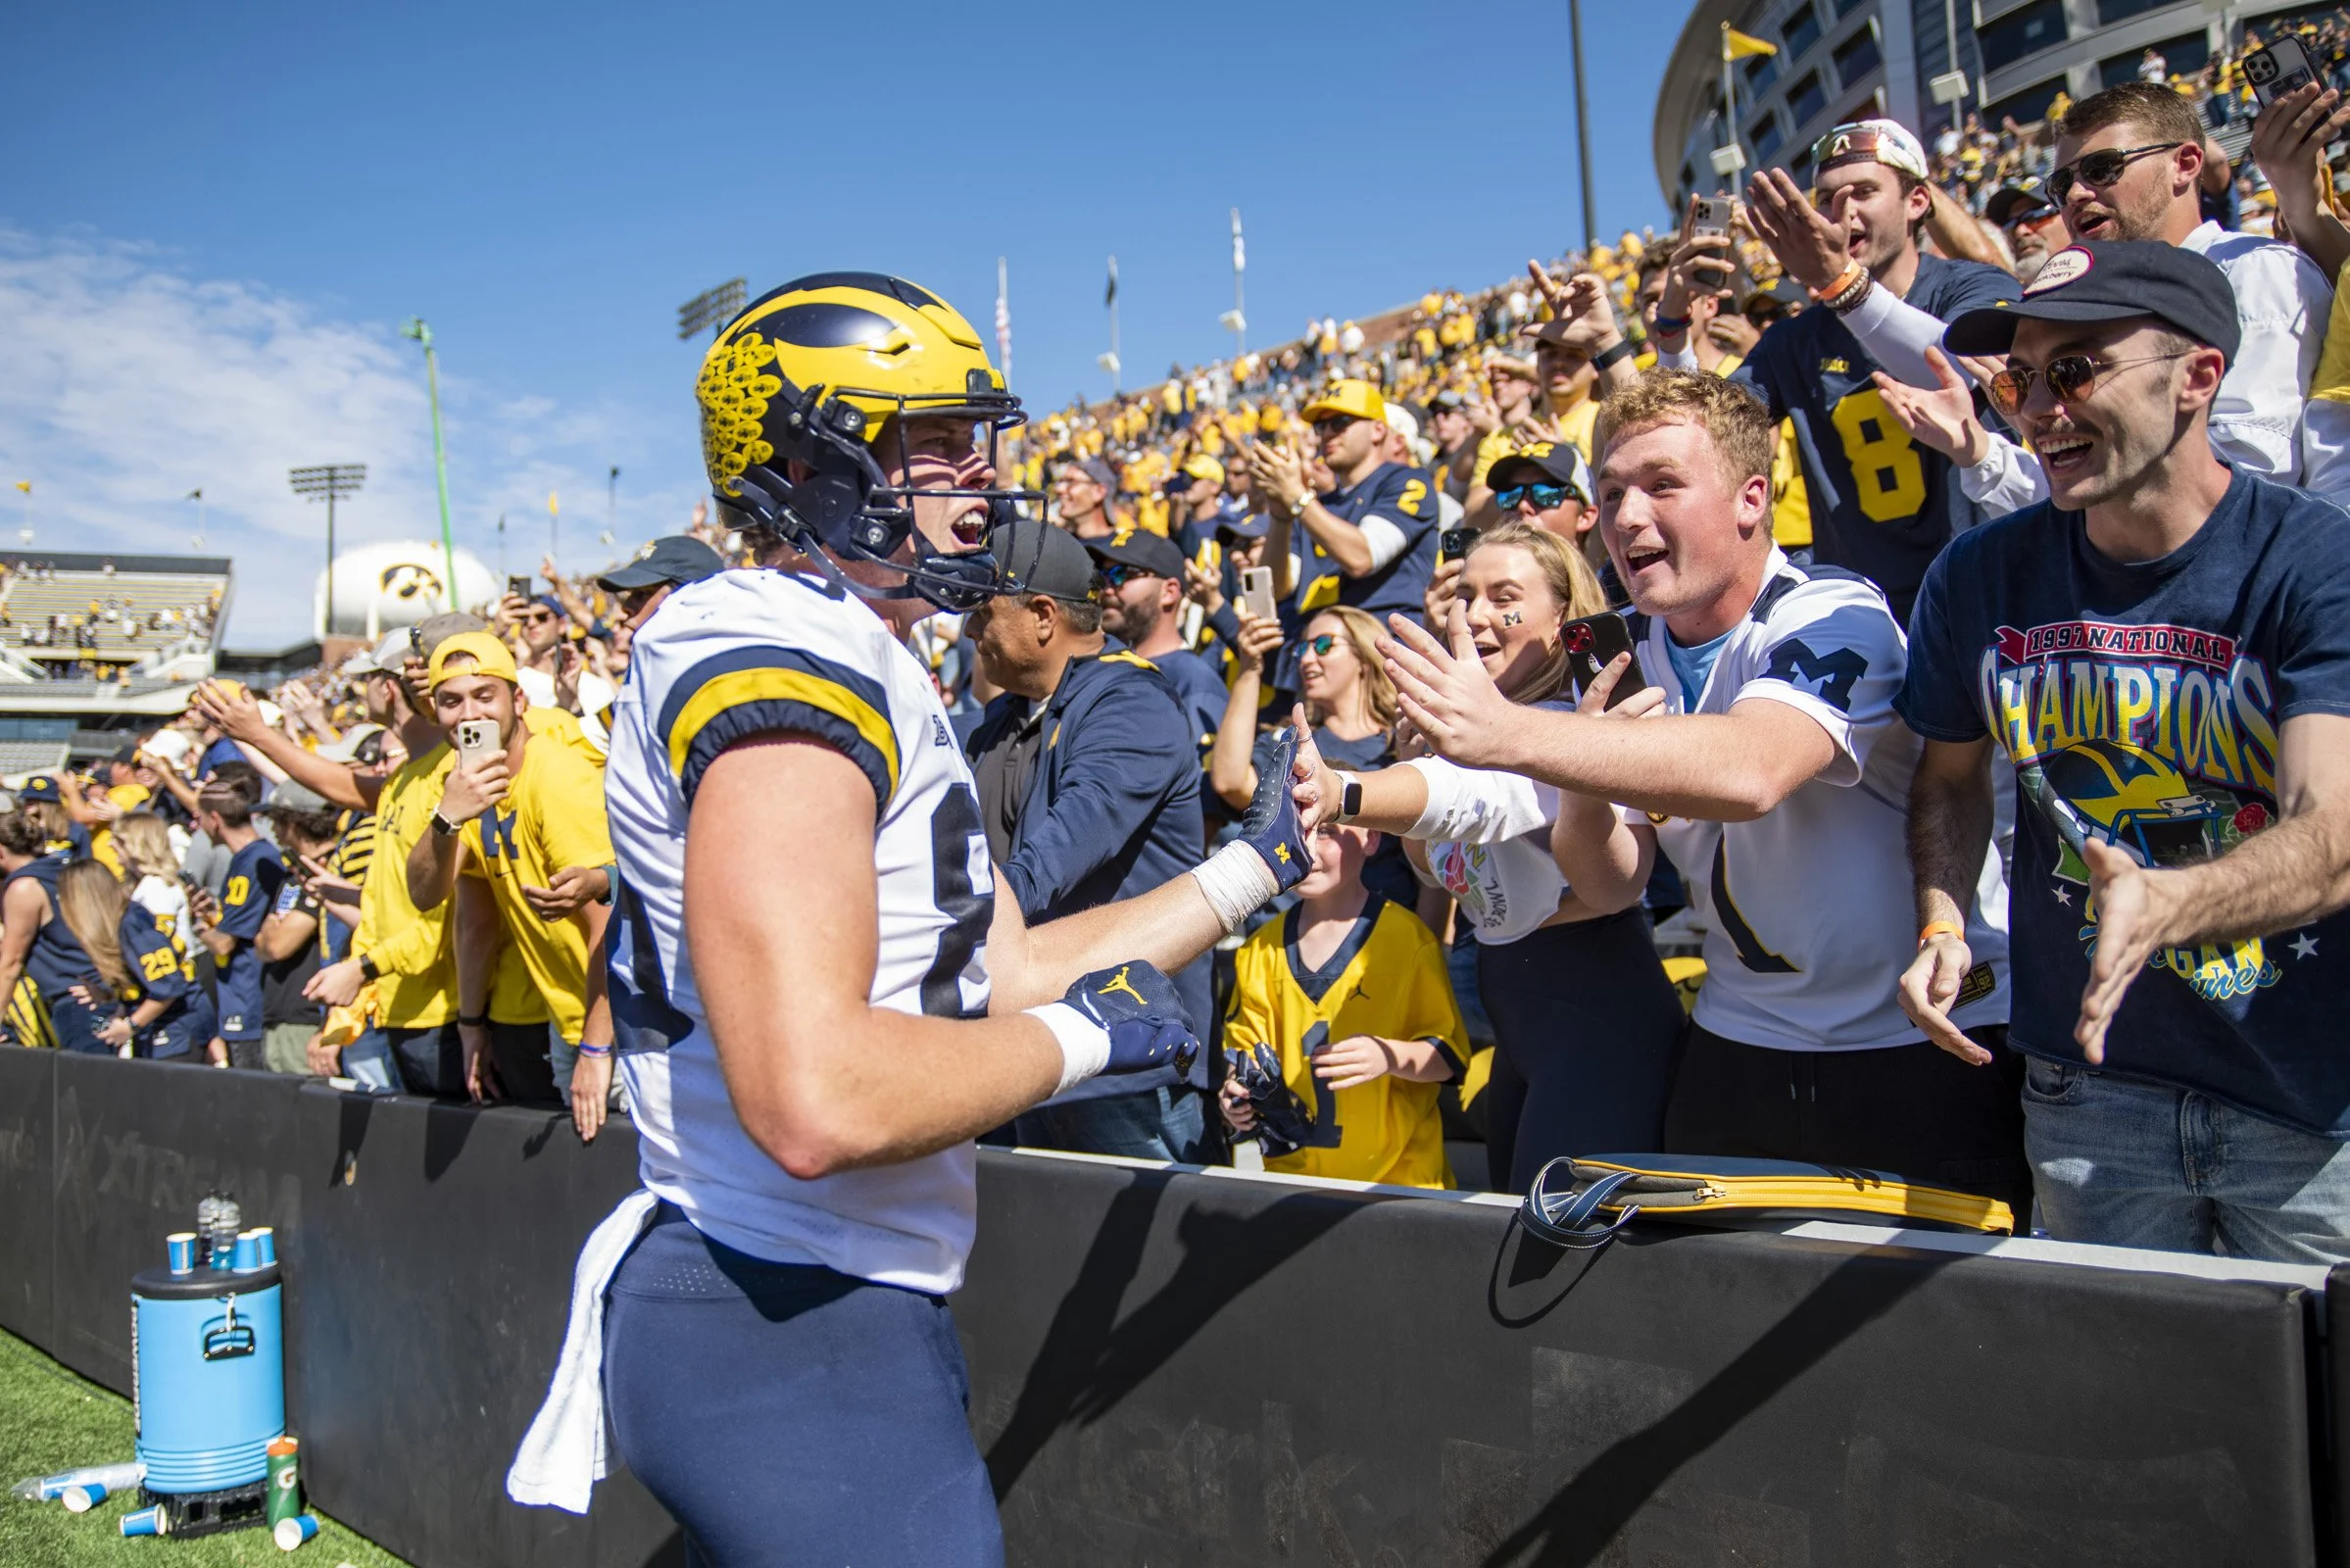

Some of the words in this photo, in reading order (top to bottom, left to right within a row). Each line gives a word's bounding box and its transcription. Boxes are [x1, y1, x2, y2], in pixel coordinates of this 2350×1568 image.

[1832, 387, 1927, 522] 8
[1396, 478, 1428, 515] 2
[1502, 611, 1524, 628] M
[2030, 624, 2084, 652] 1997
[2087, 626, 2227, 663] NATIONAL
[1757, 636, 1869, 713] M
[1979, 642, 2277, 798] CHAMPIONS
[1274, 841, 1292, 865] M
[139, 947, 178, 982] 29
[1299, 1020, 1344, 1149] 1
[277, 1466, 297, 1490] G
